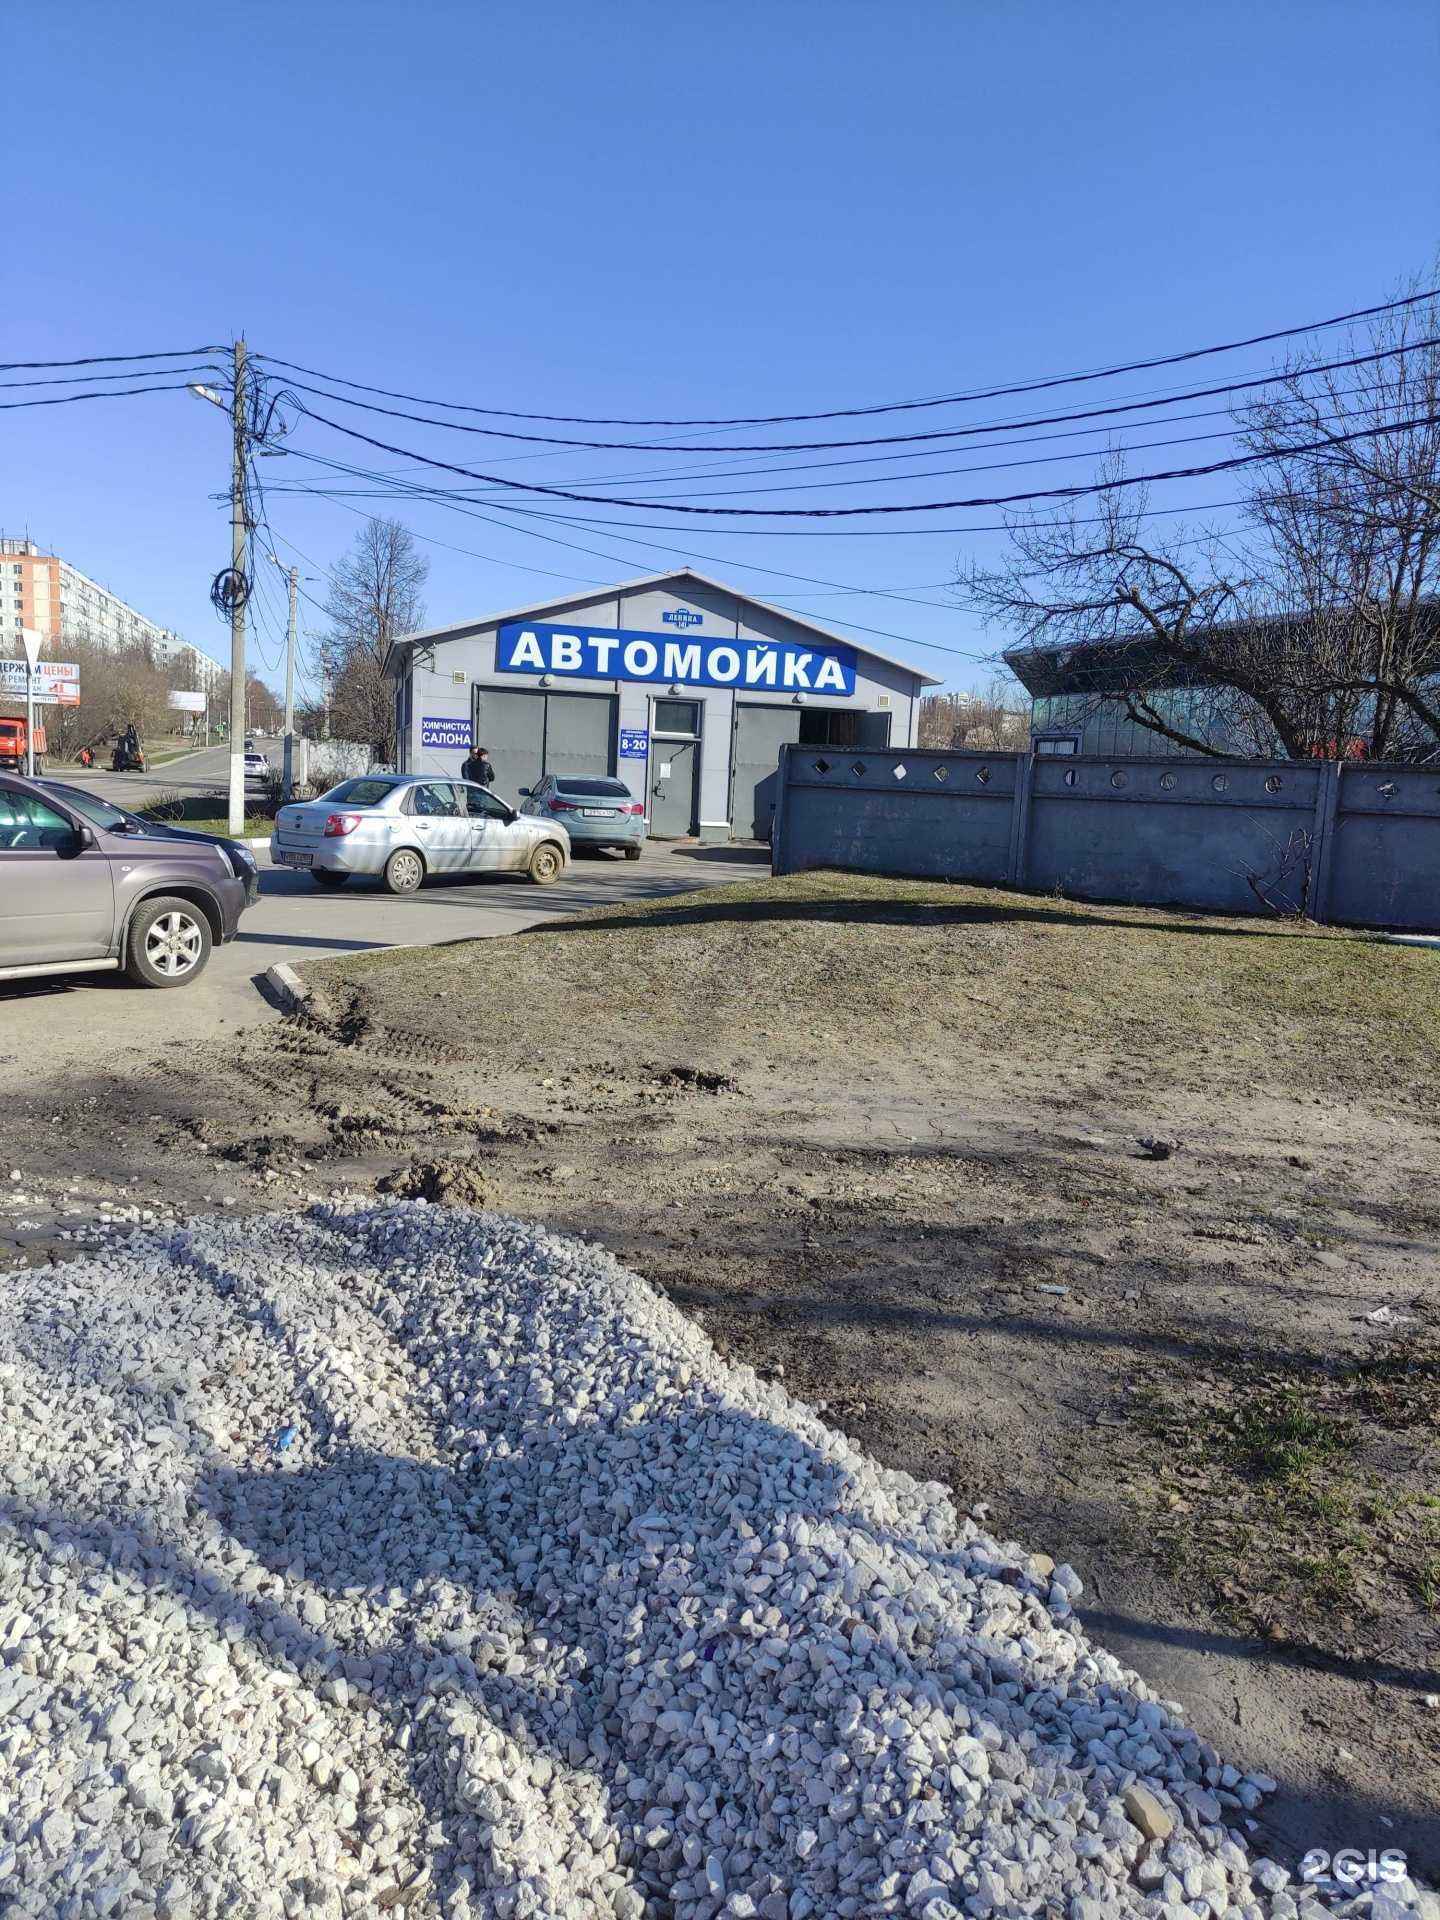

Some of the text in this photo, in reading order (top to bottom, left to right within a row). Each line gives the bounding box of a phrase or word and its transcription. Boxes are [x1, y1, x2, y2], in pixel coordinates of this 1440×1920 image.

[509, 630, 847, 691] АВТОМОЙКА
[44, 665, 73, 677] ЦЕНЫ
[8, 675, 41, 684] РЕМНТ
[423, 721, 471, 731] ХИМЧИСТКА
[422, 732, 472, 745] САЛОНА
[622, 738, 647, 751] 8-20
